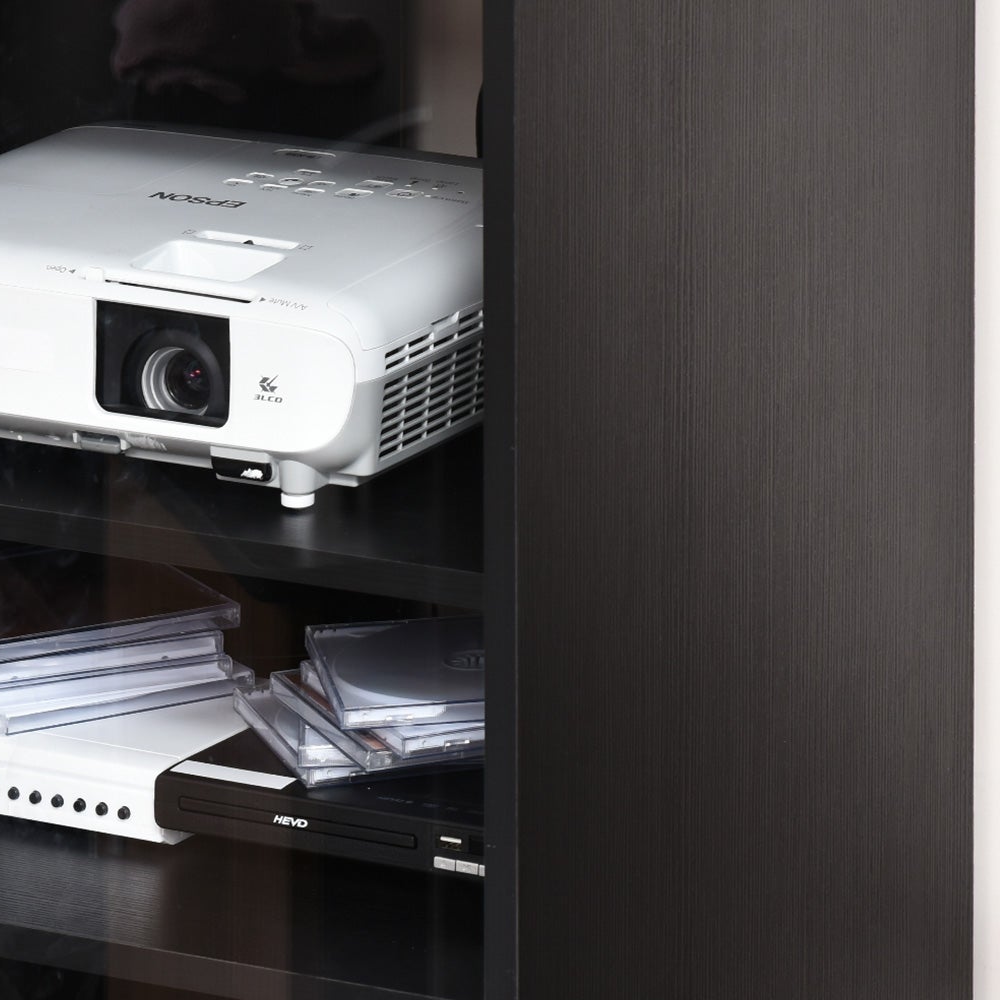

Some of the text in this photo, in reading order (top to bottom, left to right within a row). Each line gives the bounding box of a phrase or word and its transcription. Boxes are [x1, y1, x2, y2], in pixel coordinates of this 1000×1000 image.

[149, 191, 248, 209] EPSON
[46, 264, 67, 274] Open
[268, 297, 291, 308] Mute
[254, 394, 283, 403] 3LCD
[273, 814, 308, 828] HEVD
